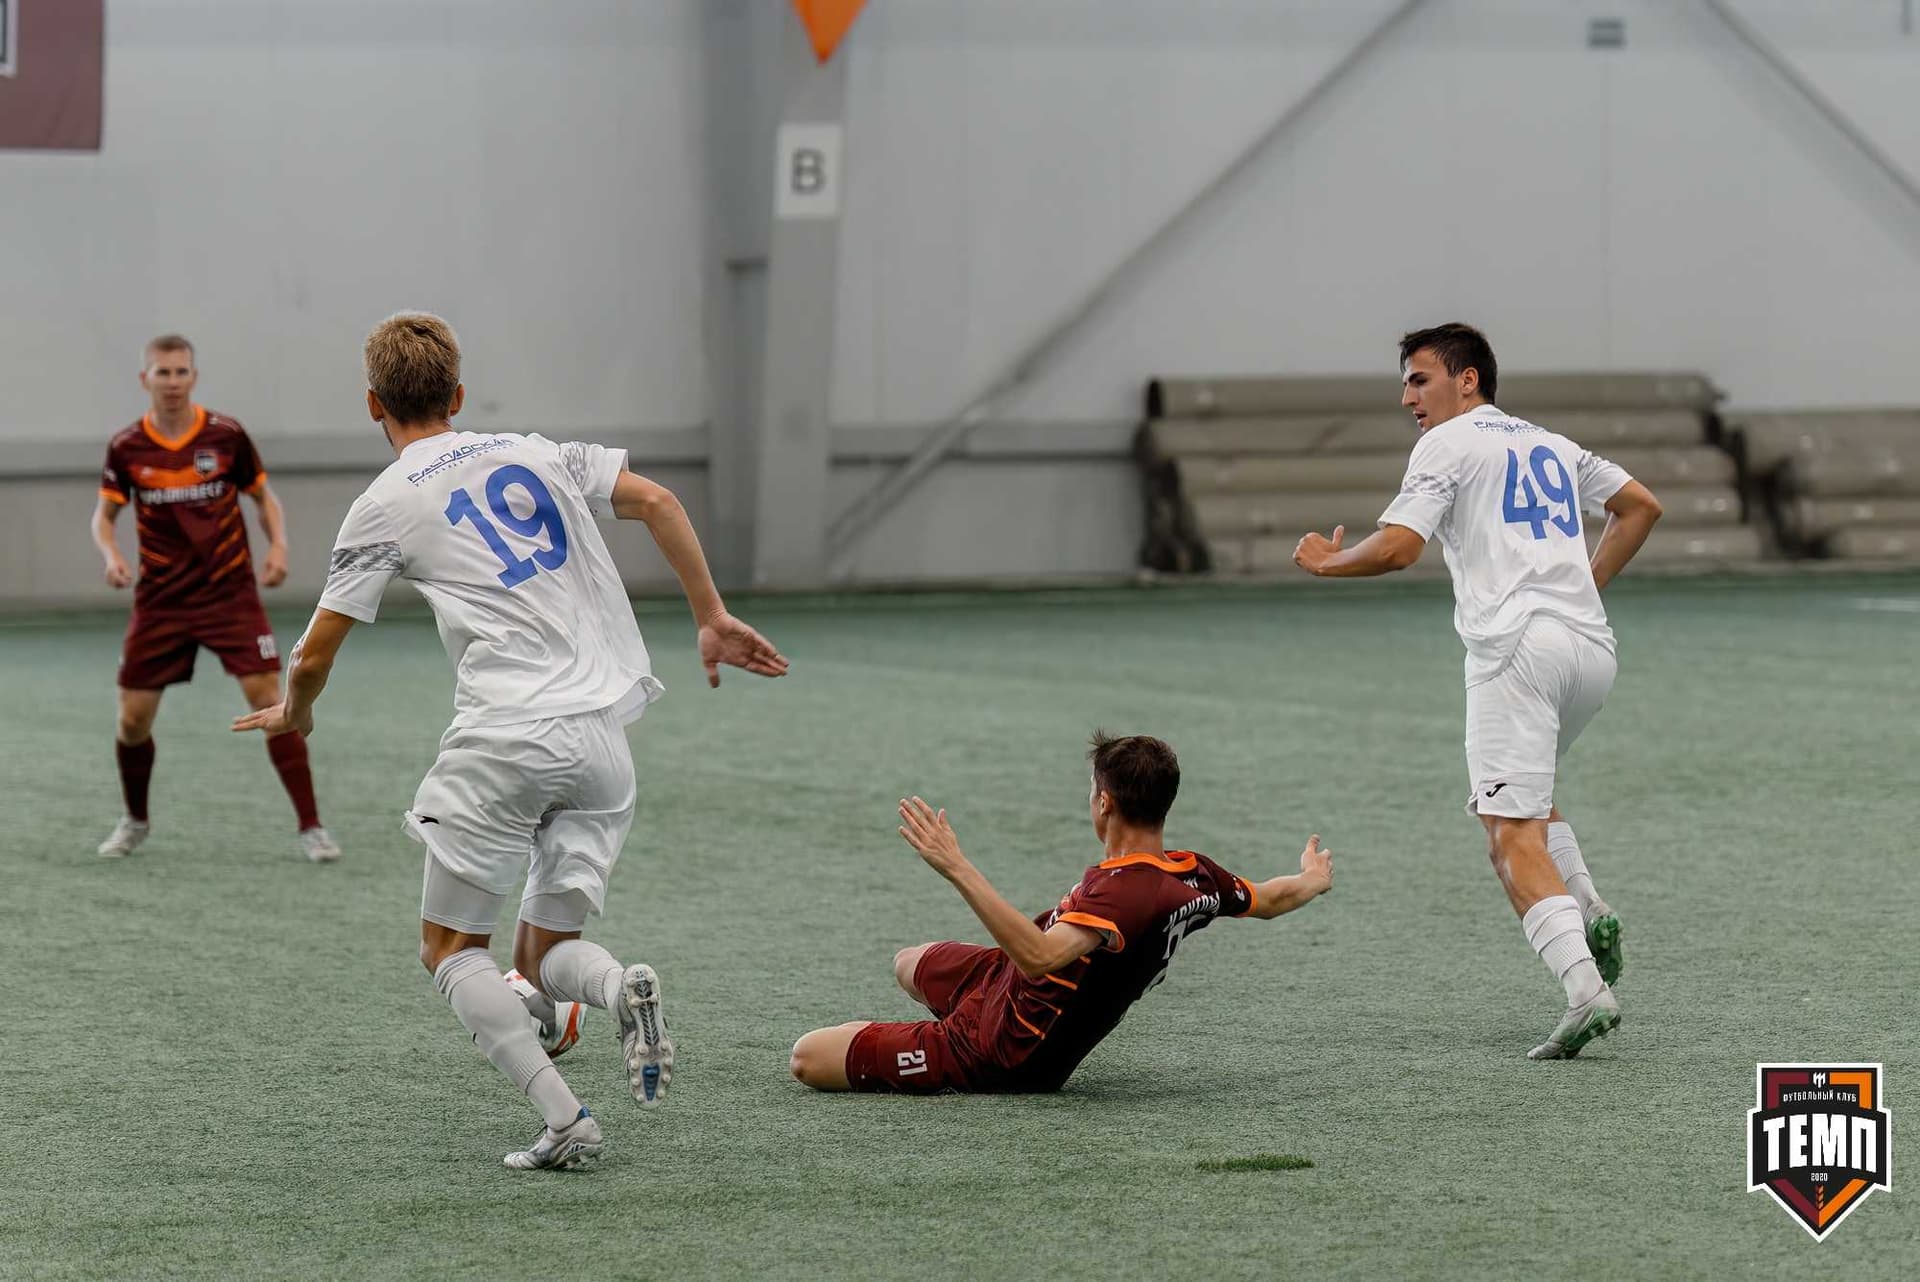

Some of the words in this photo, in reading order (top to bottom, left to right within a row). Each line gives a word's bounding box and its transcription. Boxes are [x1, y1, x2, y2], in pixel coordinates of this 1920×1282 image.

[444, 464, 567, 588] 19
[1503, 445, 1579, 540] 49
[897, 1049, 928, 1076] 21
